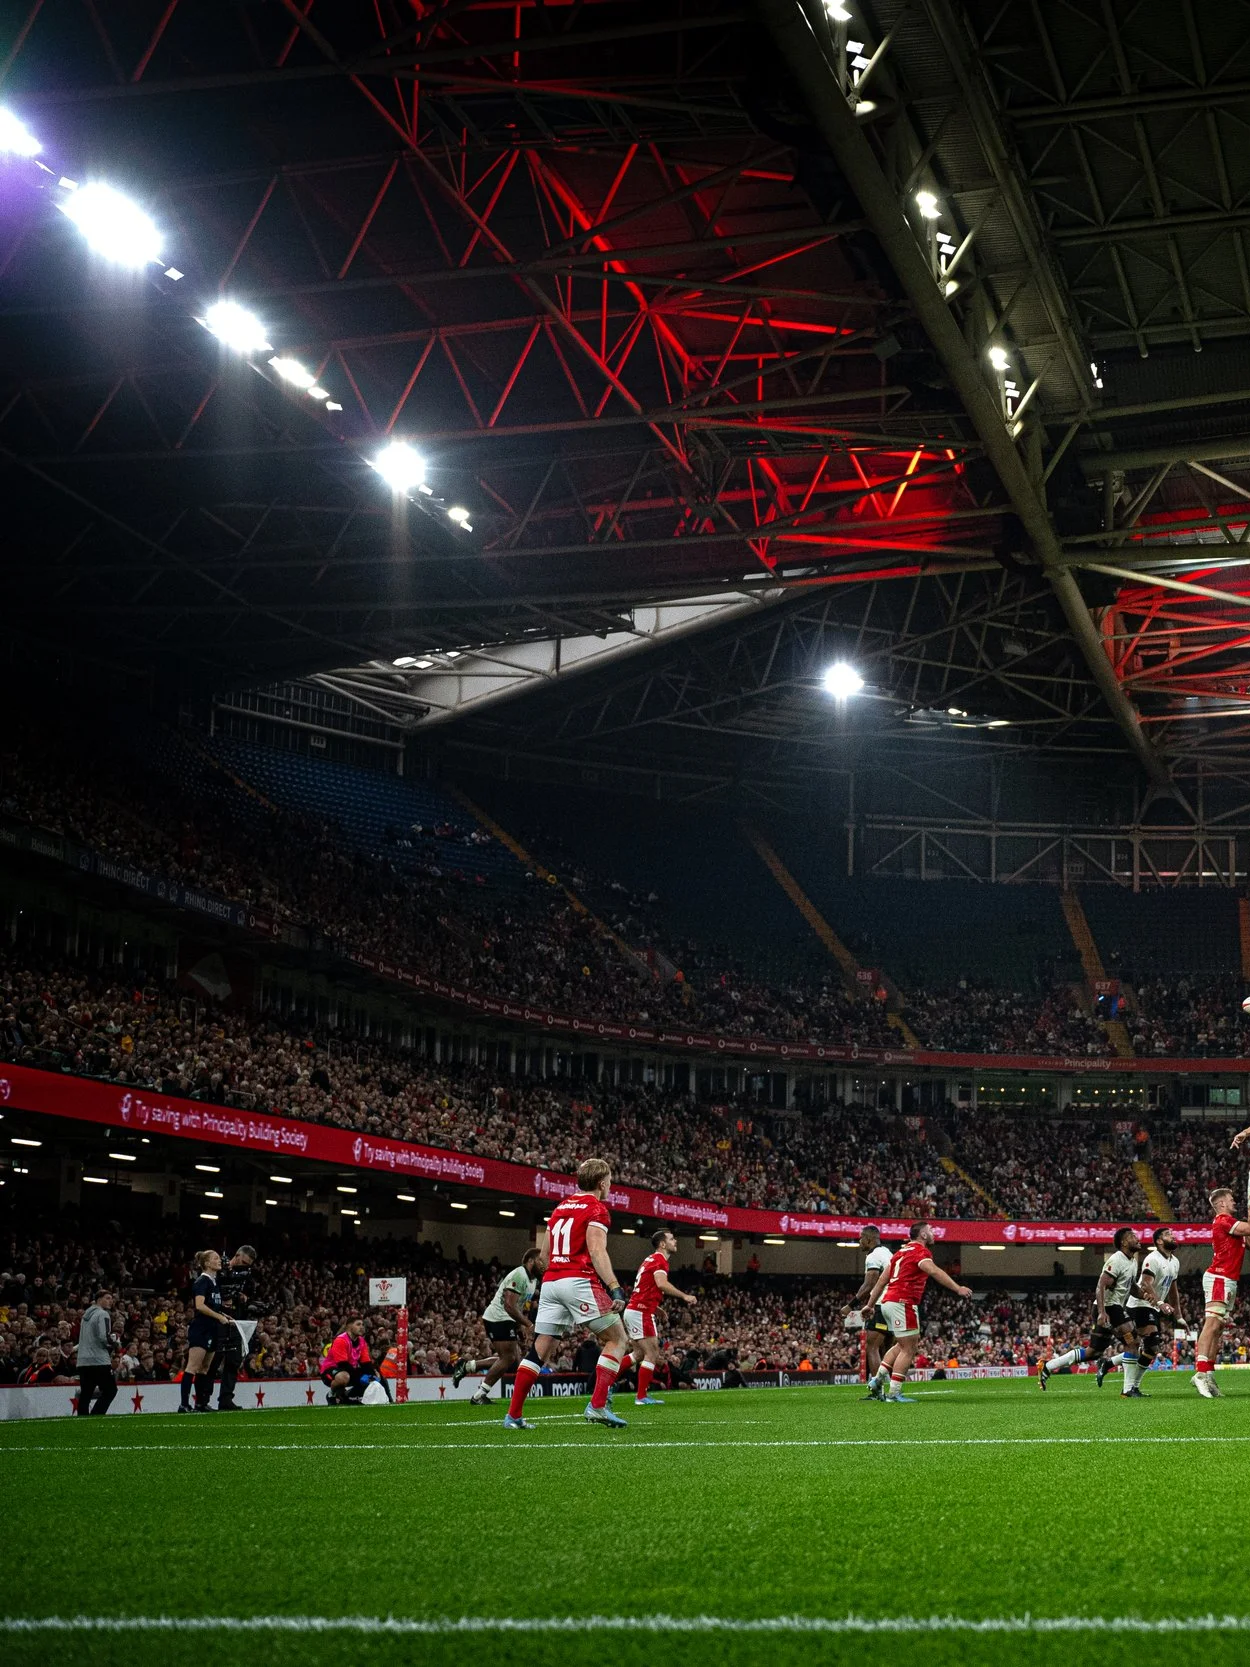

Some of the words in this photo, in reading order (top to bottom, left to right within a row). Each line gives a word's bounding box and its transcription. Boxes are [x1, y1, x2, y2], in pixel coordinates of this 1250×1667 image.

[1064, 1058, 1111, 1070] Principality
[136, 1100, 149, 1124] Try
[151, 1105, 180, 1131] saving
[182, 1108, 200, 1128] with
[203, 1112, 247, 1141] Principality
[249, 1121, 280, 1148] Building
[281, 1127, 308, 1152] Society
[1116, 1122, 1133, 1130] 437
[363, 1142, 375, 1163] Try
[375, 1146, 395, 1168] saving
[395, 1149, 410, 1166] with
[410, 1151, 441, 1176] Principality
[443, 1158, 465, 1180] Building
[465, 1162, 484, 1183] Society
[789, 1218, 800, 1232] Try
[801, 1220, 824, 1233] saving
[824, 1220, 840, 1232] with
[551, 1217, 574, 1255] 11
[1019, 1227, 1035, 1240] Try
[1036, 1228, 1065, 1240] saving
[1066, 1227, 1088, 1238] with
